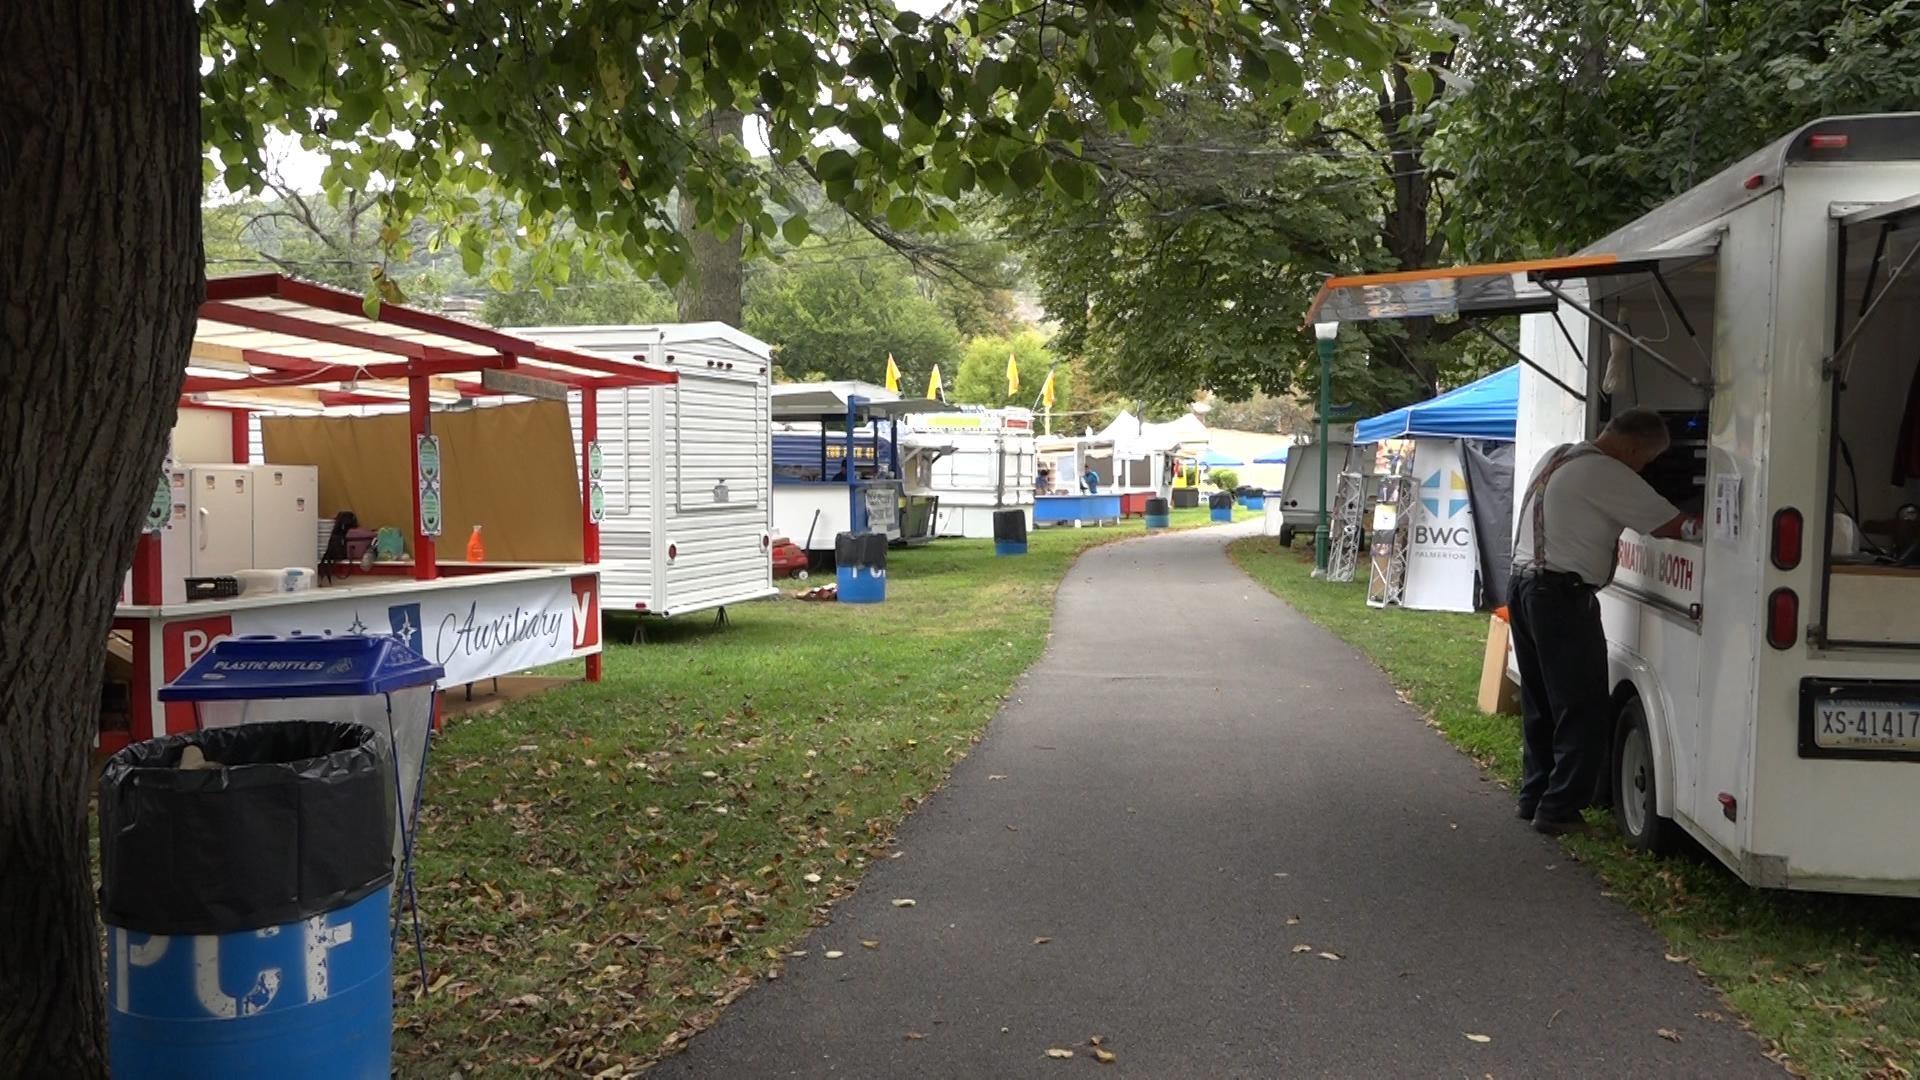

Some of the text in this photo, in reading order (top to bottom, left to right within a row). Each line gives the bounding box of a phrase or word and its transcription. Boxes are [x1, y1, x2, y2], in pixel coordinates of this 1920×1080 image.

[1415, 526, 1469, 546] BWC
[1659, 552, 1693, 591] BOOTH
[436, 599, 564, 666] Auxiliary
[213, 660, 325, 671] PLASTIC BOTTLES
[1823, 710, 1920, 738] XS-41417
